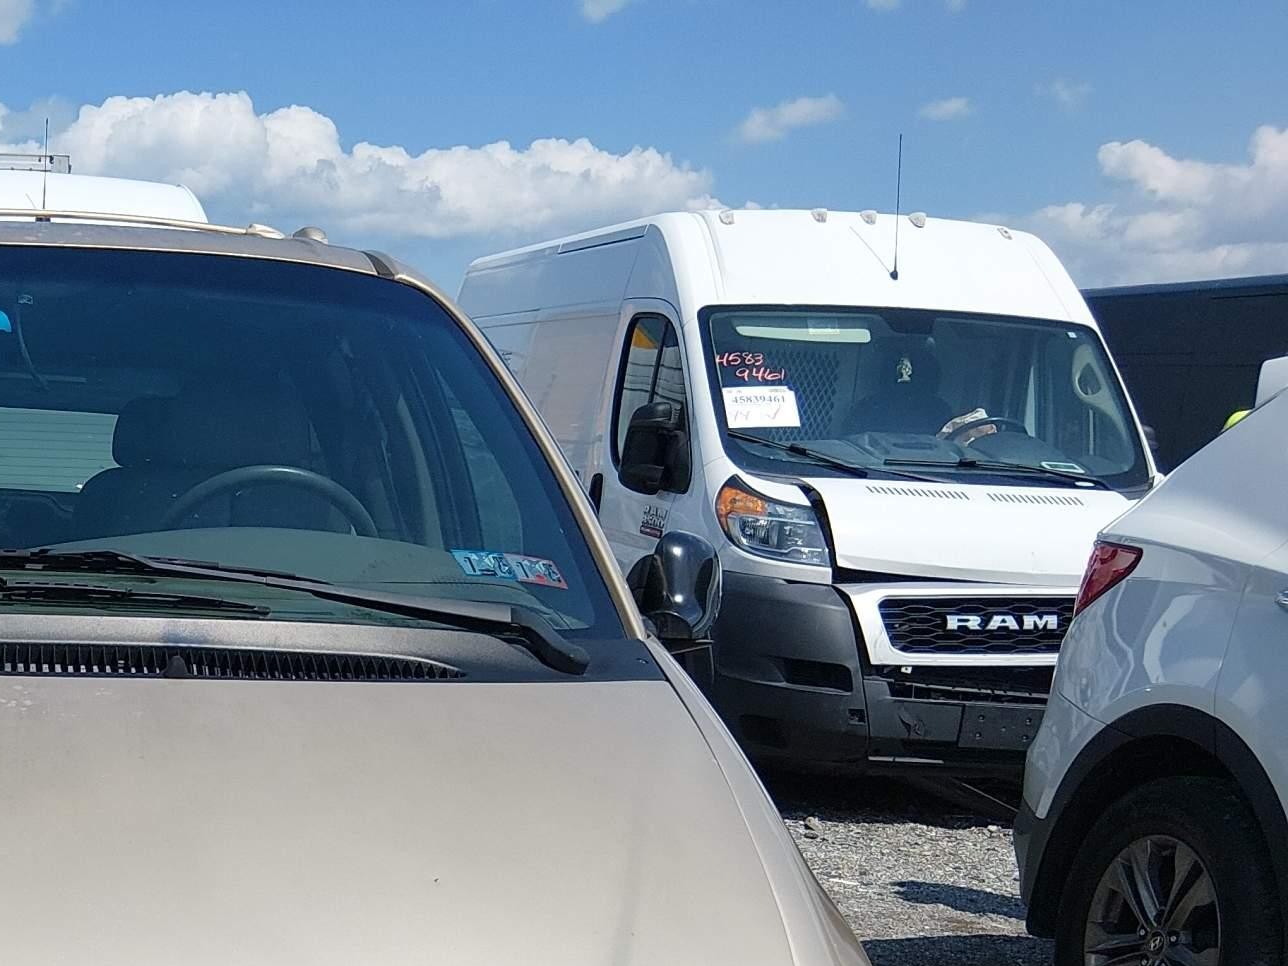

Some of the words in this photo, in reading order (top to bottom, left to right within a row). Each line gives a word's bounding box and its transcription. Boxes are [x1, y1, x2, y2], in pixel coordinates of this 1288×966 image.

[715, 352, 763, 366] 4583
[736, 367, 785, 381] 9461
[732, 395, 785, 404] 45839461
[946, 615, 1058, 630] RAM
